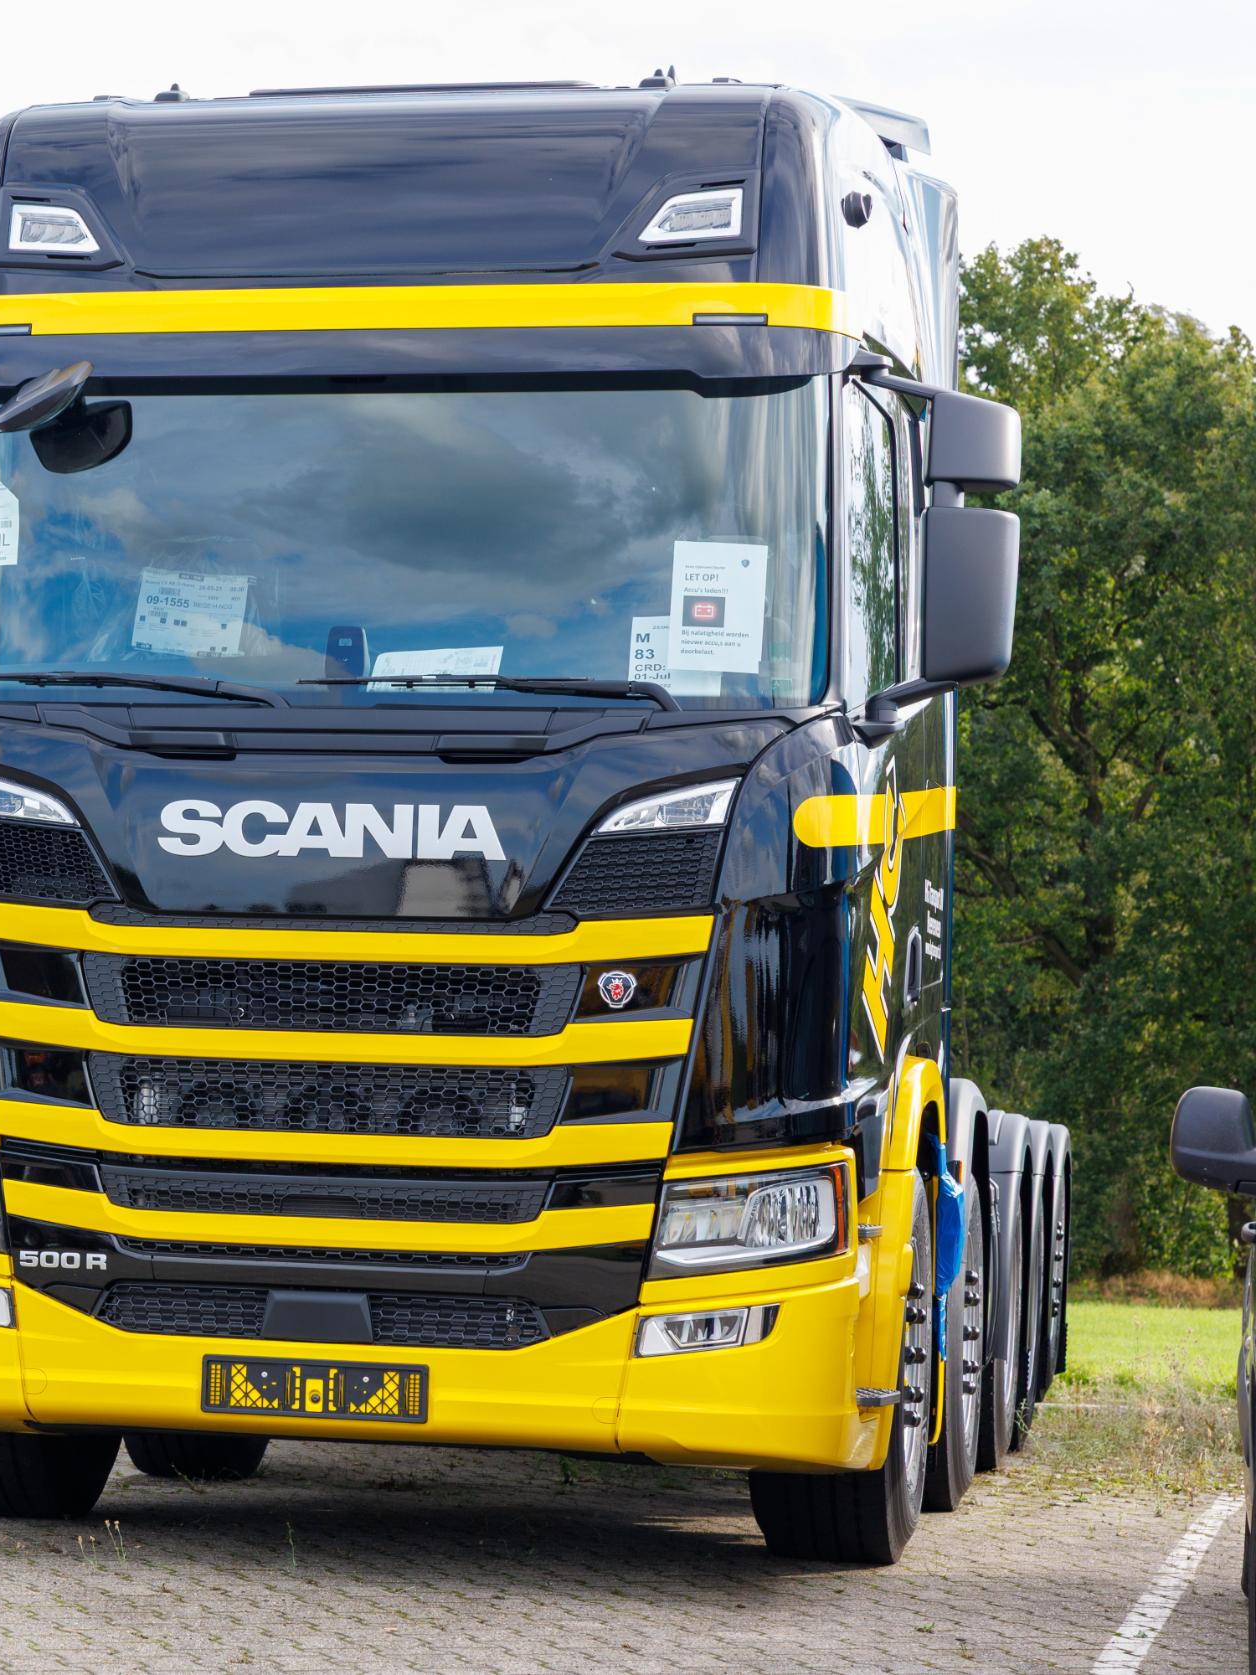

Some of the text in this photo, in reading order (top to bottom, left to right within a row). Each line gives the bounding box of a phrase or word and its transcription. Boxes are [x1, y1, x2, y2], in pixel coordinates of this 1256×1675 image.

[685, 573, 719, 582] LET OP!
[146, 594, 191, 609] 09-1555
[635, 633, 651, 643] M
[634, 649, 655, 660] 83
[635, 663, 666, 672] CRD:
[157, 799, 507, 861] SCANIA
[19, 1250, 108, 1271] 500 R
